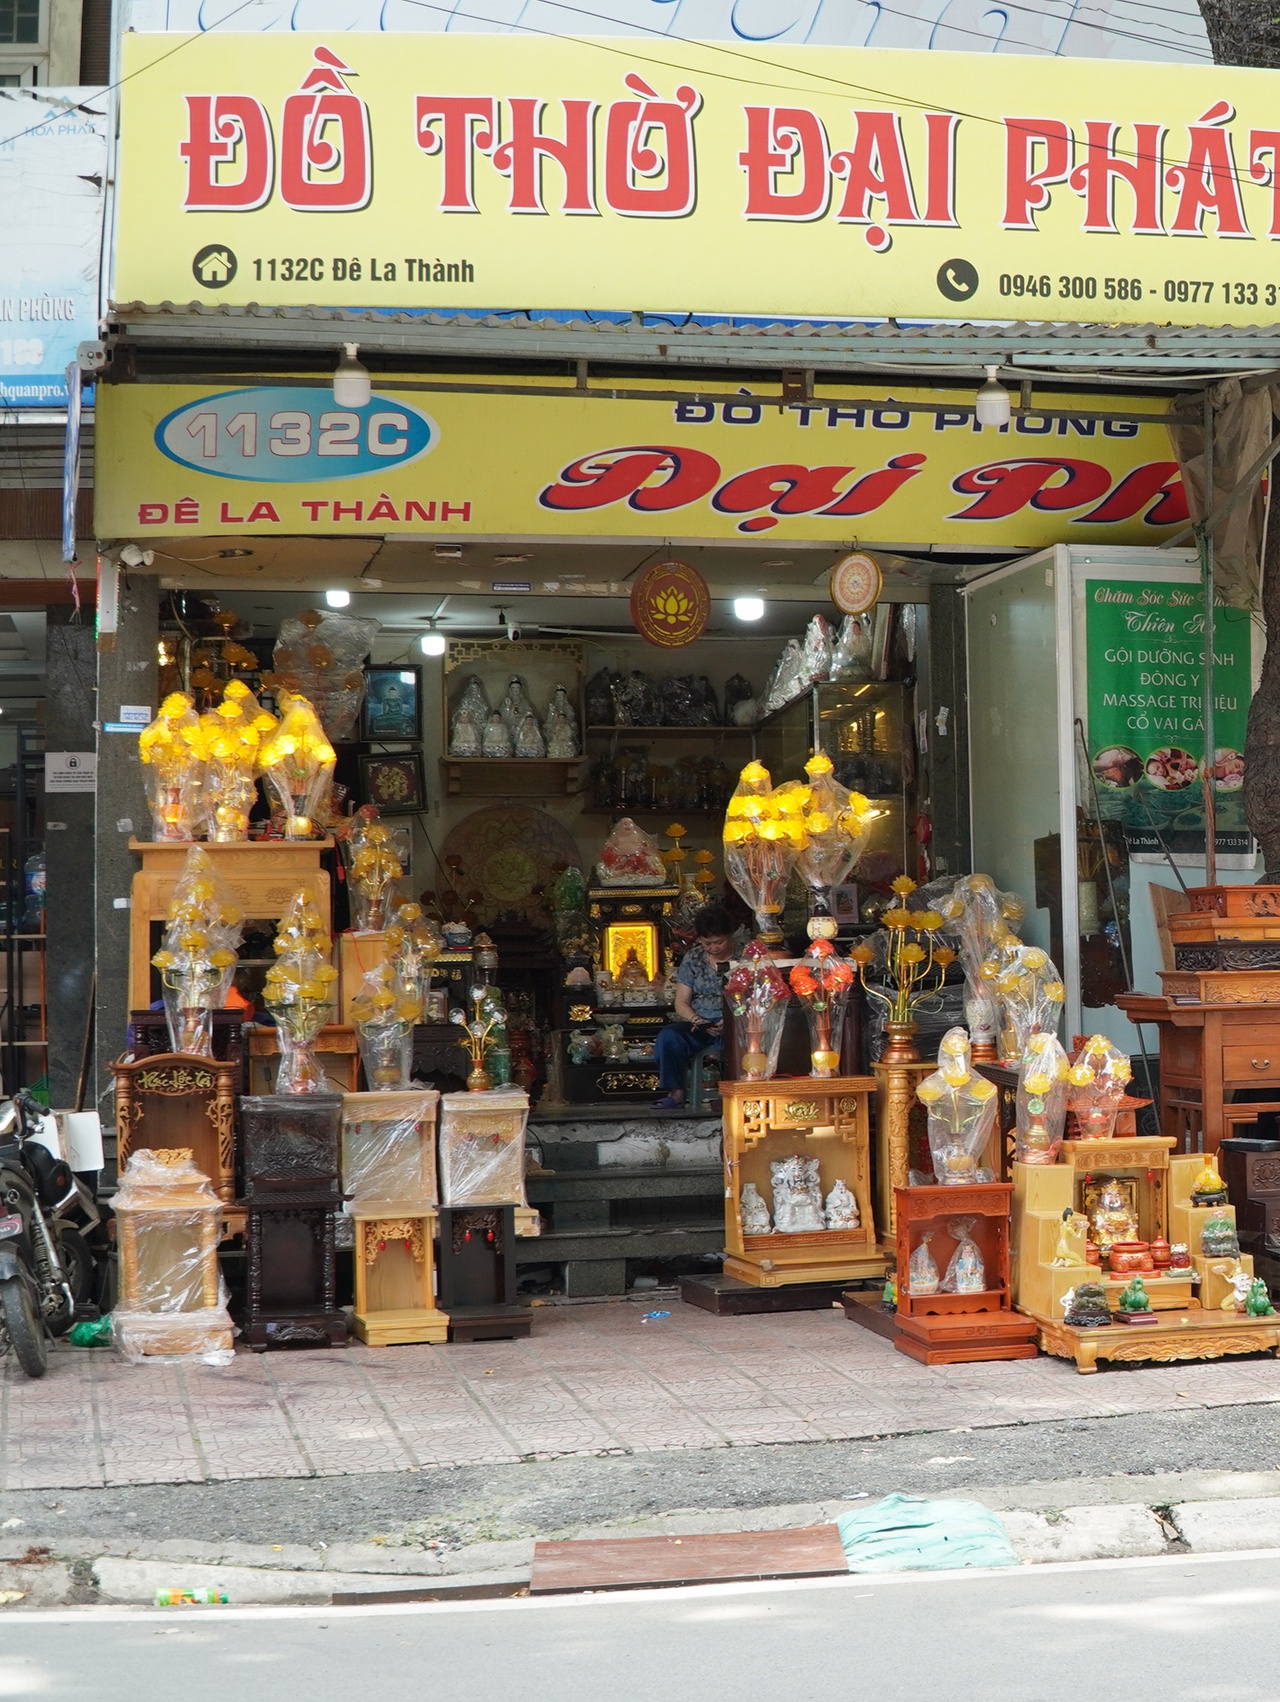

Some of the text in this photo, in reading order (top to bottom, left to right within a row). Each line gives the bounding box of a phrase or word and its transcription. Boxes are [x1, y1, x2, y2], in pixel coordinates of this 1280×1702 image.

[180, 46, 372, 212] ĐỒ
[415, 72, 702, 216] THỜ
[738, 105, 961, 252] ĐẠI
[252, 257, 475, 284] 1132C Đê La Thành
[999, 273, 1051, 298] 0946
[1058, 275, 1098, 300] 300
[1104, 276, 1142, 301] 586
[1164, 278, 1215, 304] 0977
[1222, 281, 1259, 305] 133
[19, 293, 75, 321] PHÒNG
[186, 411, 410, 457] 1132C
[537, 445, 1193, 532] Đại Ph
[138, 493, 472, 525] ĐÊ LA THÀNH
[1094, 587, 1134, 604] Chăm
[1137, 589, 1164, 606] Sóc
[1167, 590, 1195, 607] Sức
[1105, 647, 1234, 666] GỘI DƯỠNG SNH
[1140, 670, 1200, 686] ĐÔNG Y
[1103, 693, 1177, 708] MASSAGE
[1181, 695, 1202, 712] TRỊ
[1127, 710, 1205, 730] CỔ VAI GÁ
